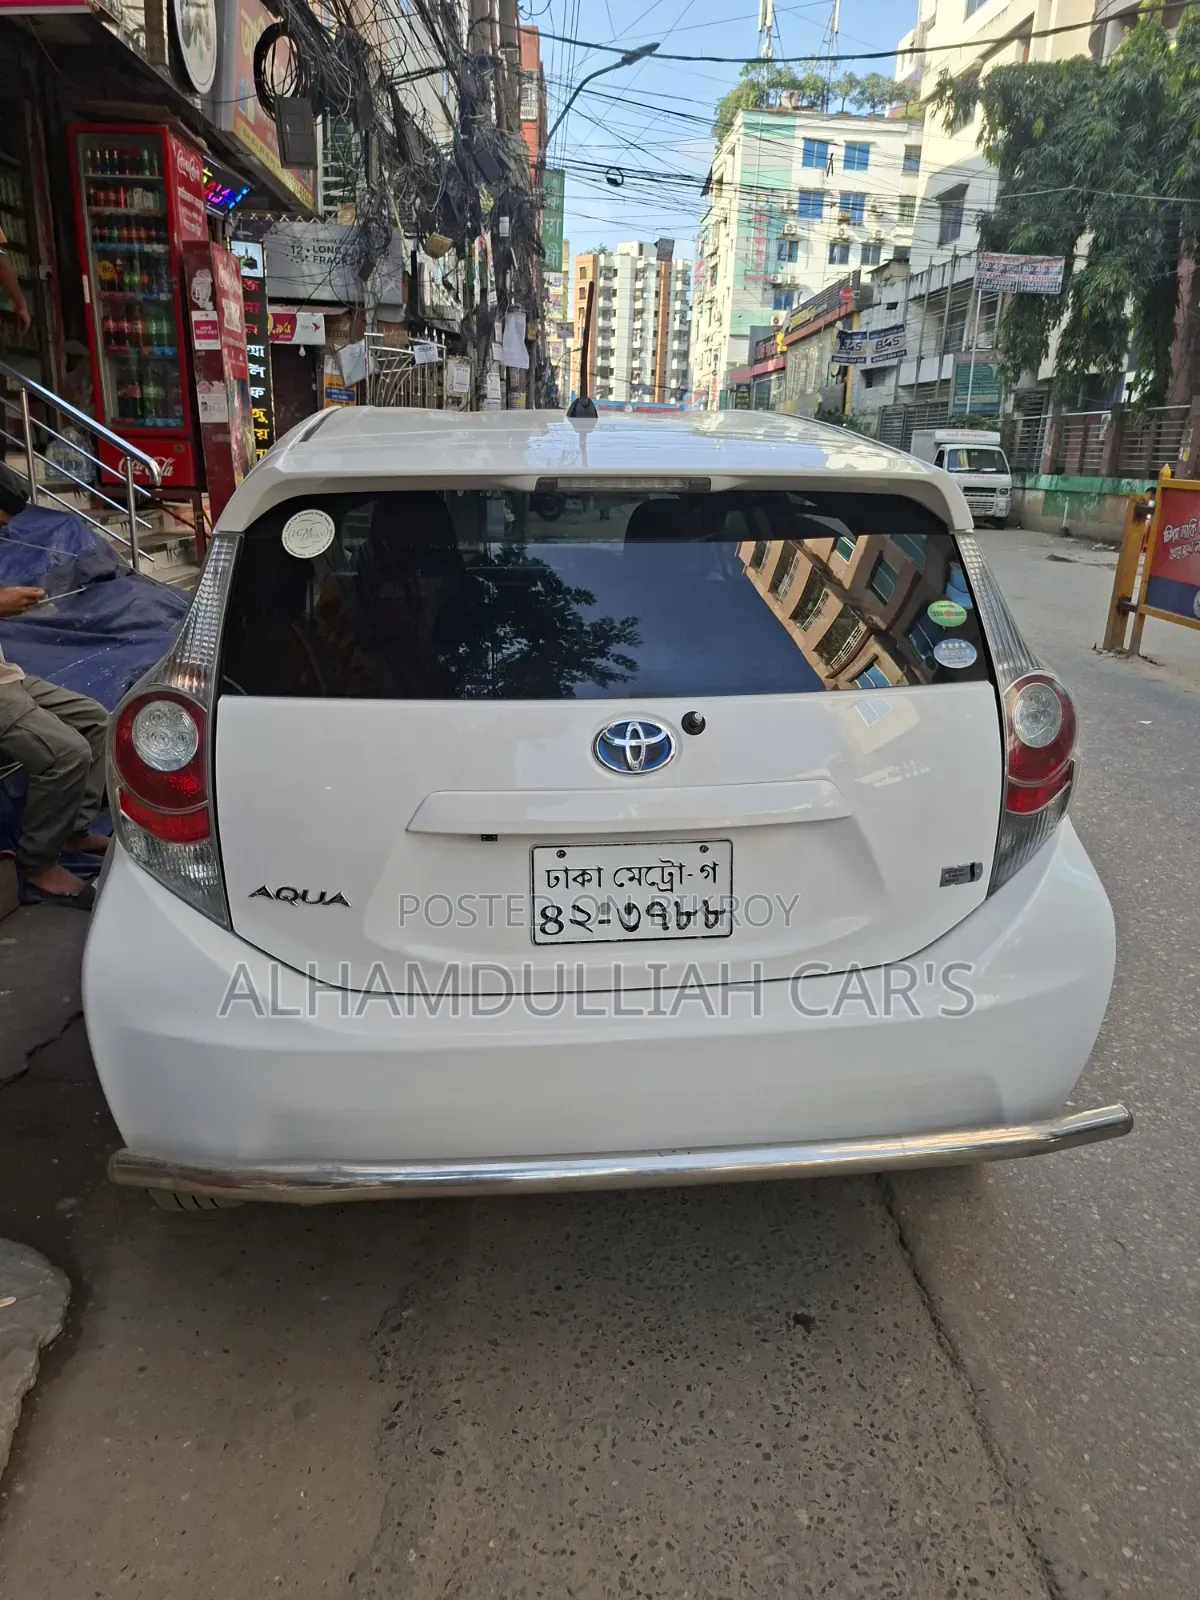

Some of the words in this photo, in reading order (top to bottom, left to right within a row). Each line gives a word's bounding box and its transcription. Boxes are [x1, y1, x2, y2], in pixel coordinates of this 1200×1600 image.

[290, 244, 303, 255] 12
[313, 245, 342, 254] LONG
[545, 864, 604, 889] ঢাকা
[248, 884, 352, 907] AQUA
[539, 899, 726, 936] ৪২-৩৭৮৮
